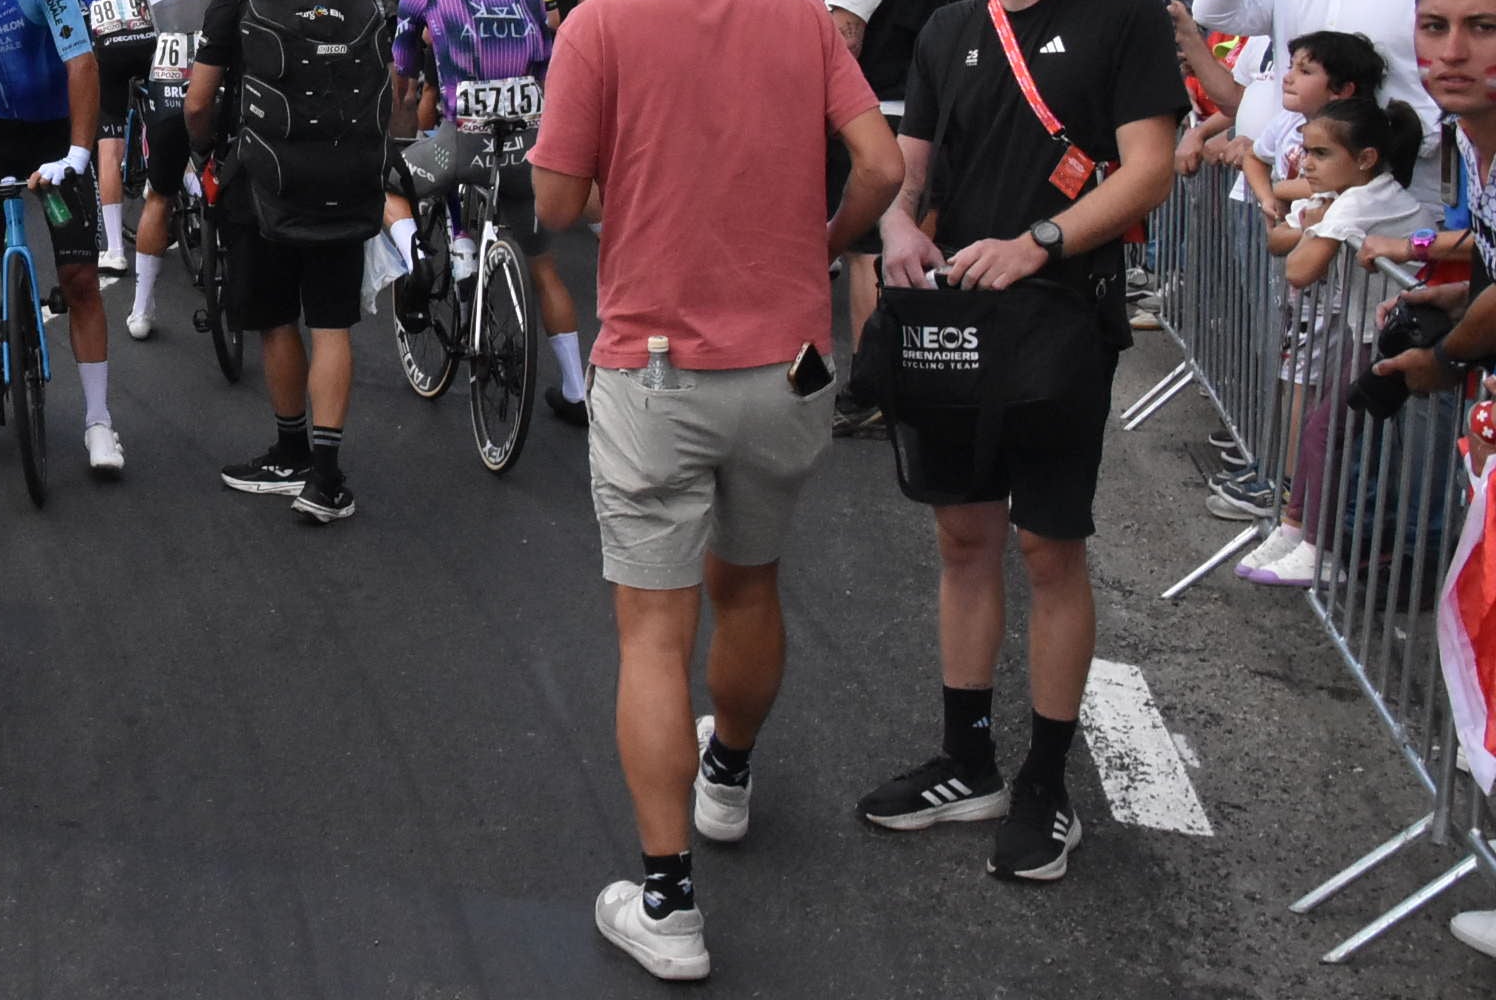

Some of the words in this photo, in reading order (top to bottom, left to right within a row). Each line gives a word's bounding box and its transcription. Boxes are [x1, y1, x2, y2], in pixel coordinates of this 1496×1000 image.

[93, 1, 115, 23] 98
[460, 20, 538, 41] ALULA
[158, 39, 180, 67] 76
[164, 86, 188, 98] BRU
[459, 87, 502, 118] 157
[902, 325, 979, 350] INEOS
[902, 350, 980, 361] GRENADIERS
[902, 361, 945, 370] CYCLING
[950, 362, 980, 370] TEAM
